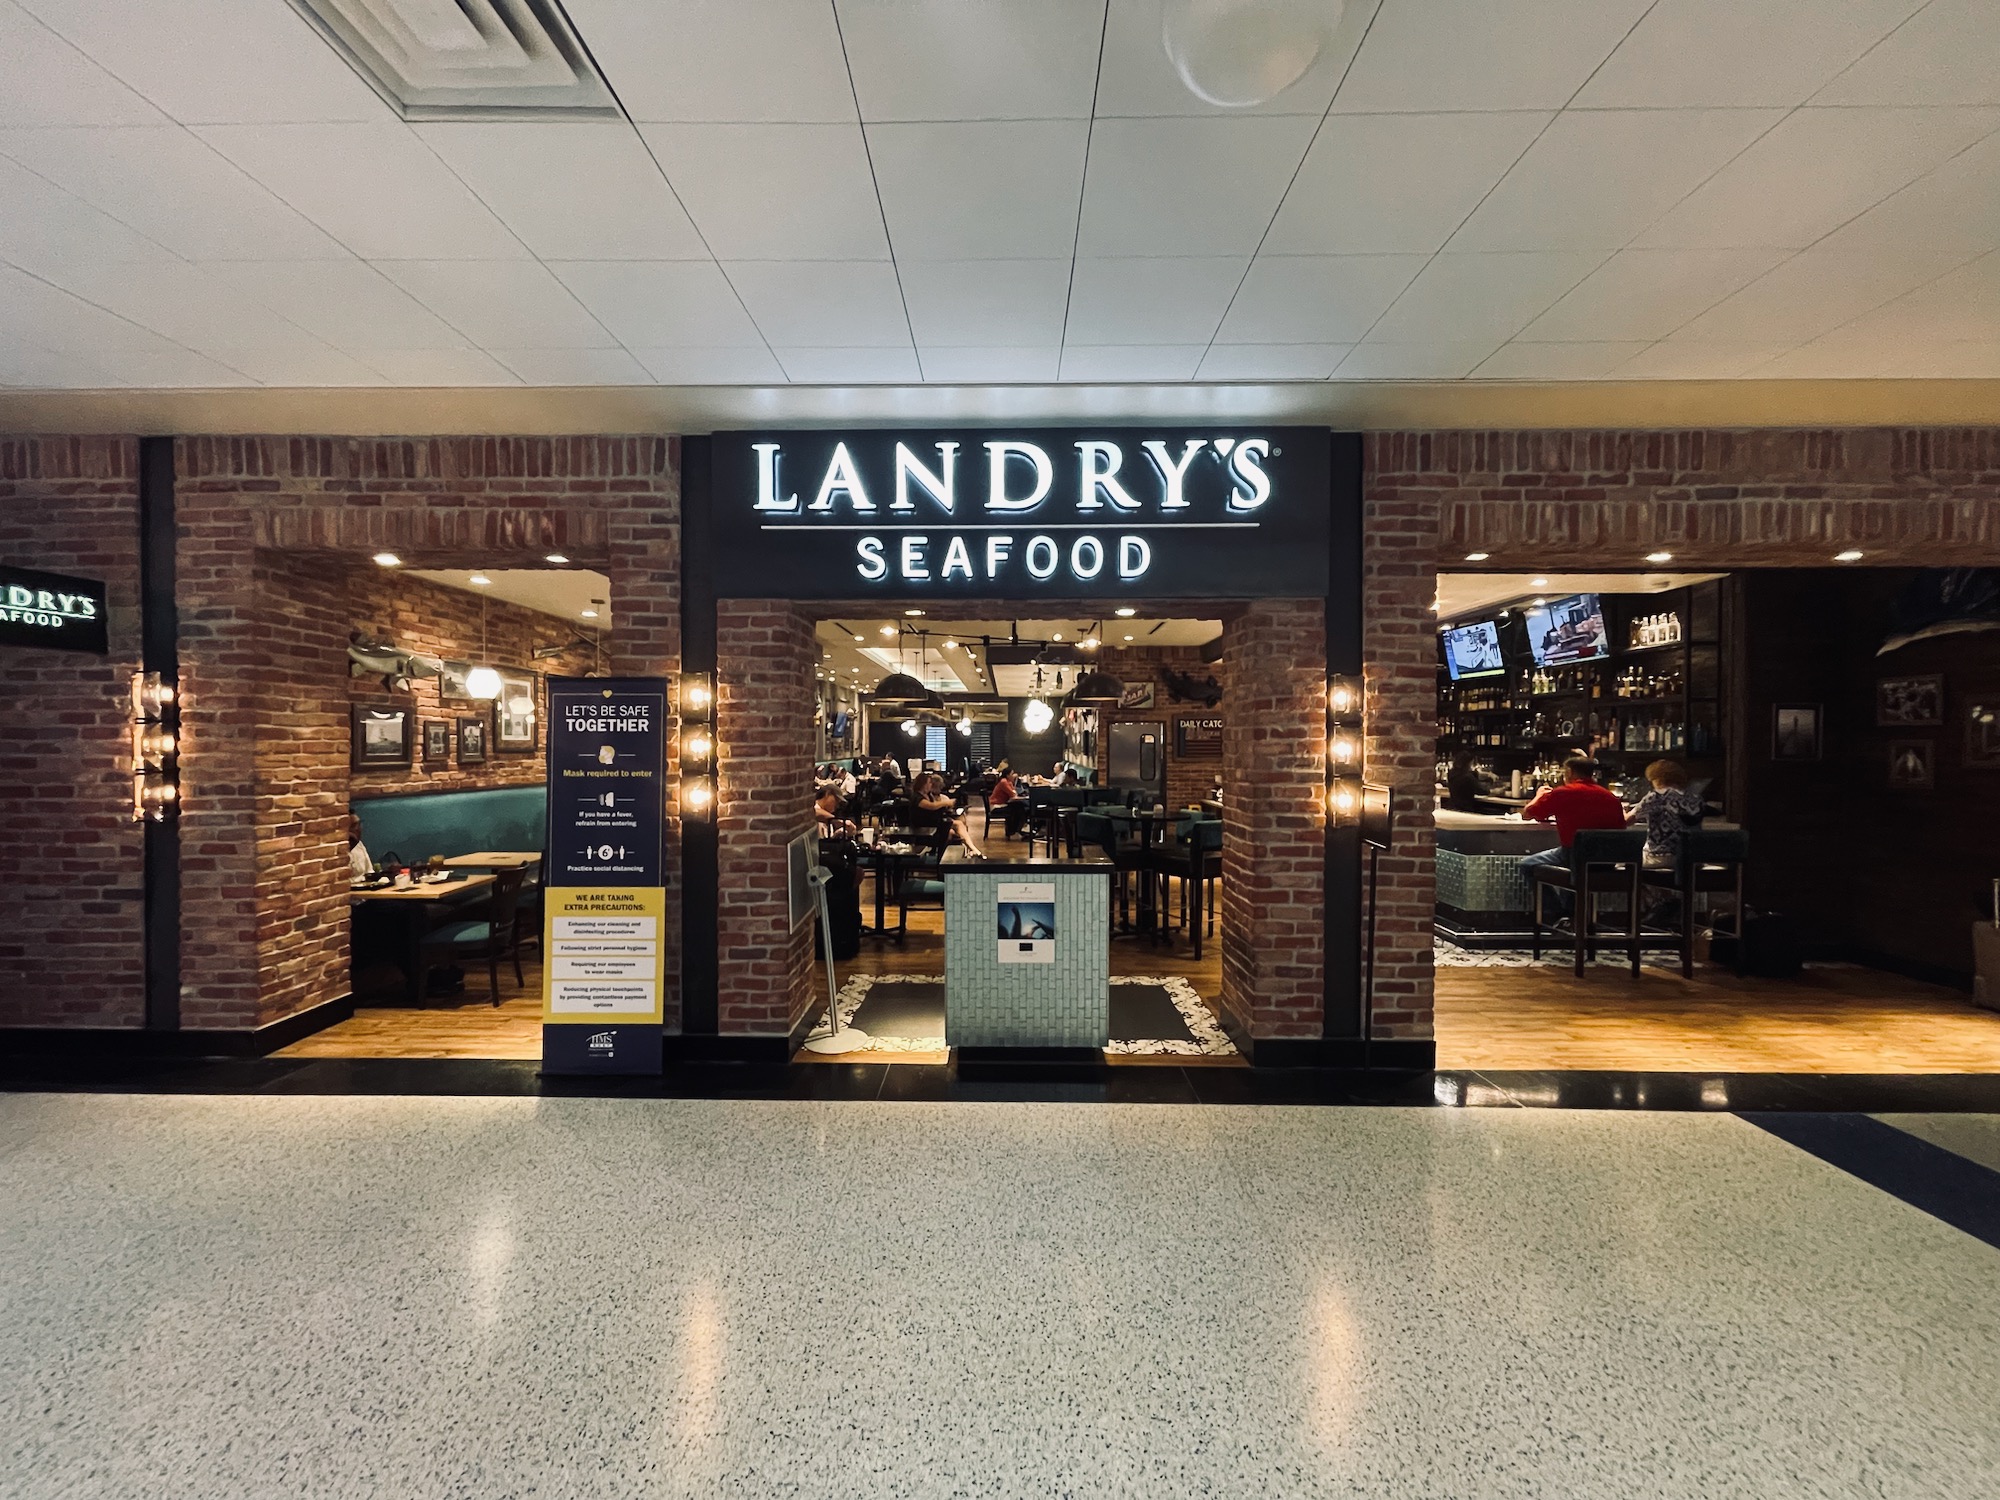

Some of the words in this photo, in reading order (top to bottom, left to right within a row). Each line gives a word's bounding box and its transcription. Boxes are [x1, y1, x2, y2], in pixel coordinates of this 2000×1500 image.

[751, 439, 1271, 511] LANDRY'S
[856, 535, 1151, 580] SEAFOOD
[565, 705, 598, 716] LET'S
[600, 705, 616, 716] BE
[619, 705, 649, 716] SAFE
[565, 718, 649, 732] TOGETHER
[1179, 719, 1201, 728] DAILY
[1202, 719, 1223, 728] CATC
[563, 769, 585, 777] Mask
[587, 769, 619, 778] required
[621, 769, 629, 777] to
[611, 820, 637, 828] entering
[612, 865, 644, 873] distancing
